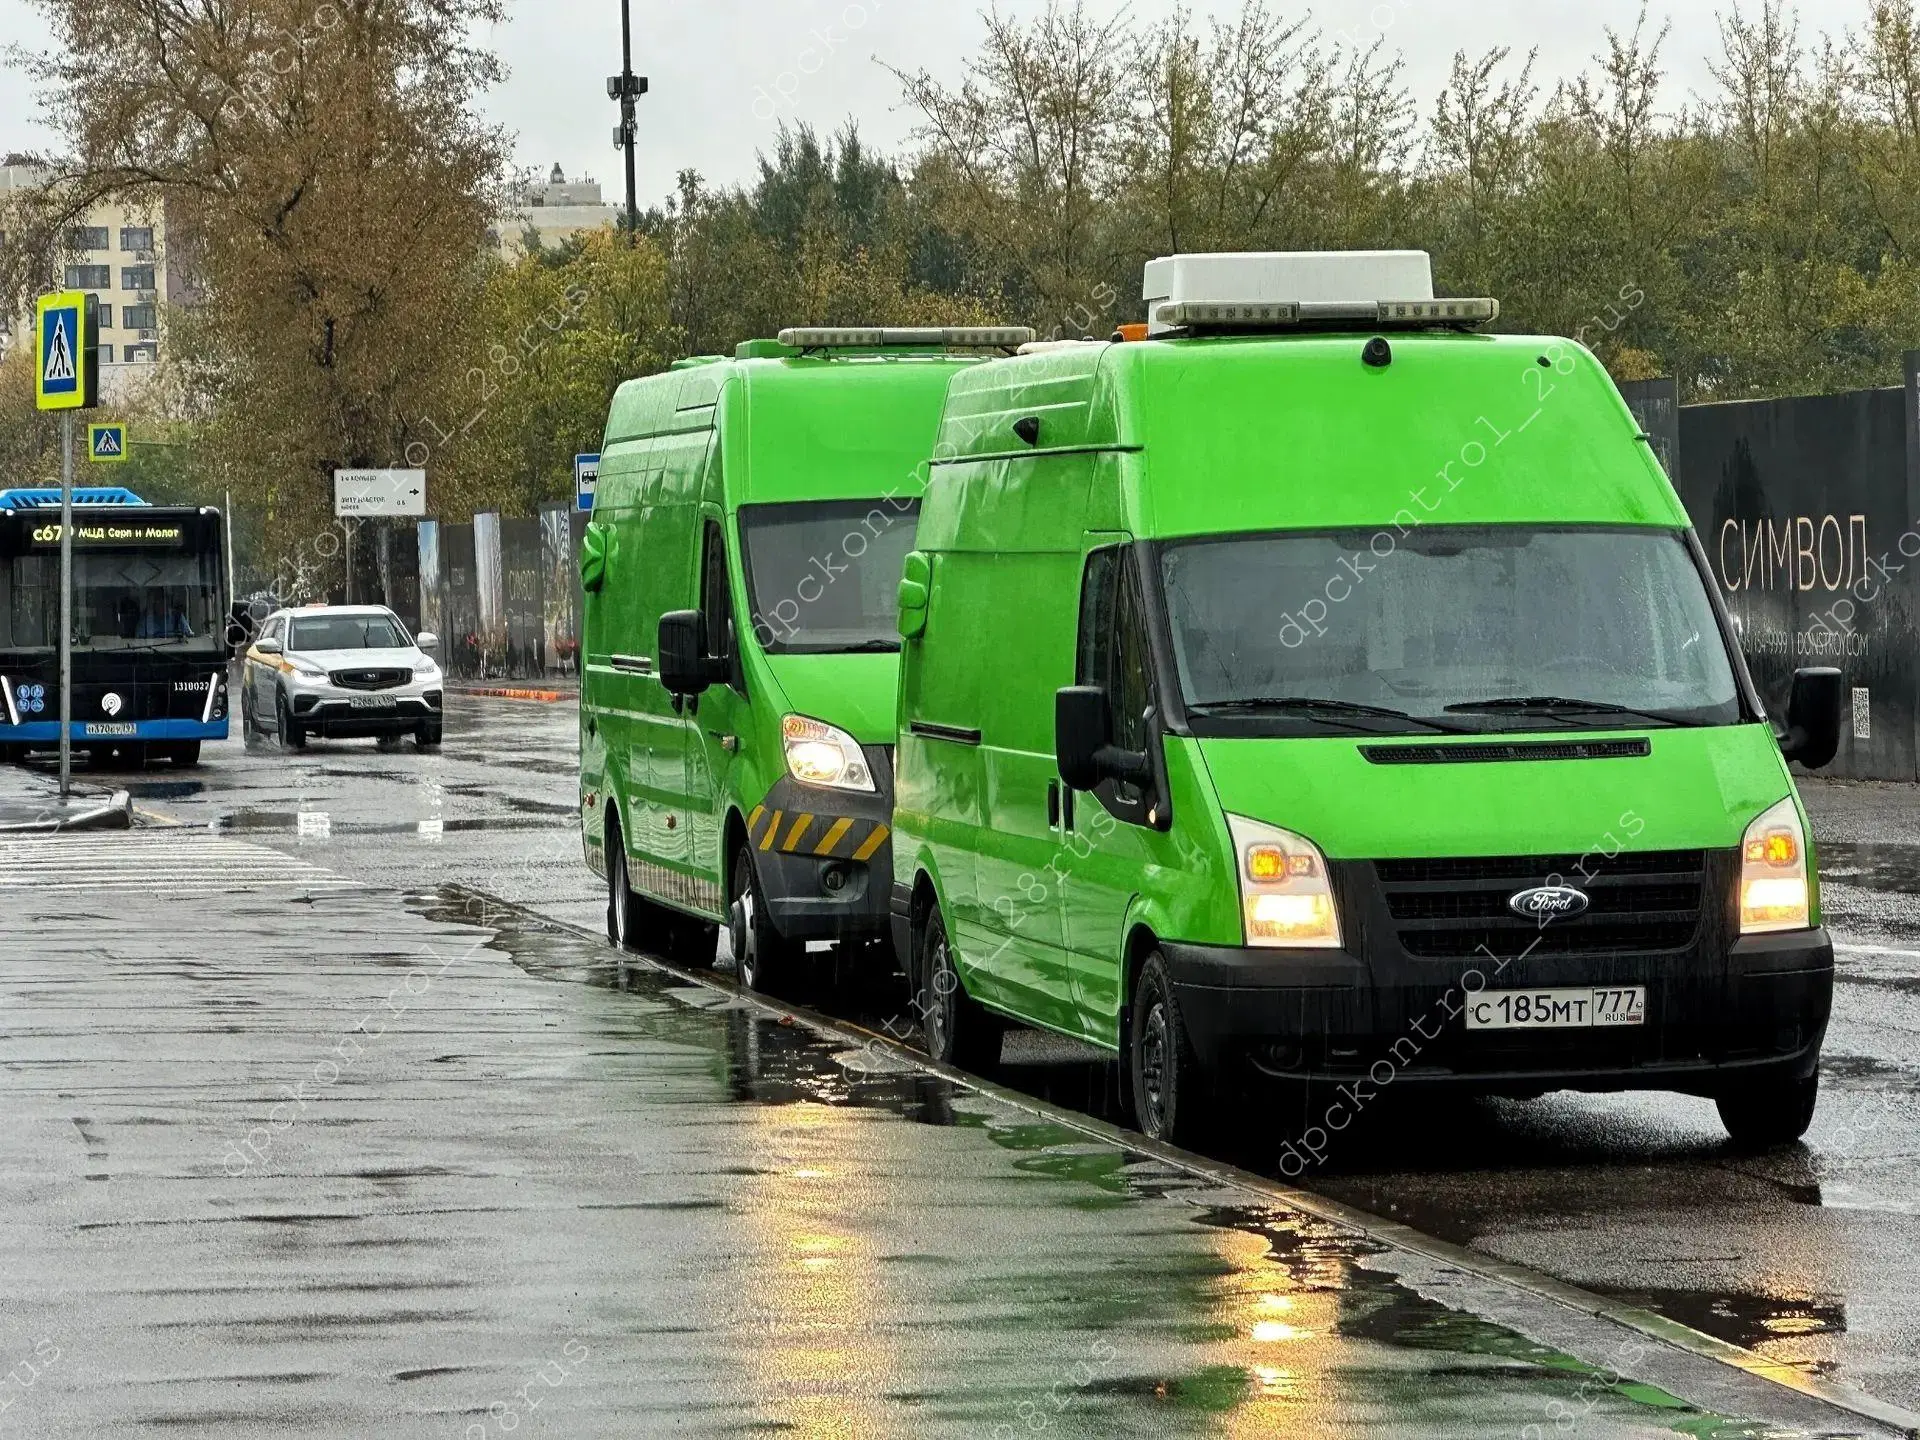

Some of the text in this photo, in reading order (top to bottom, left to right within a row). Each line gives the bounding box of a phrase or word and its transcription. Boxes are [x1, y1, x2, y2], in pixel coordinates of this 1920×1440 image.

[33, 525, 179, 541] с67 МЦД Серп и Молот
[1721, 515, 1868, 592] СИМВОЛ
[1529, 891, 1572, 912] Ford
[1594, 989, 1638, 1014] 777
[1604, 1012, 1627, 1022] RUS
